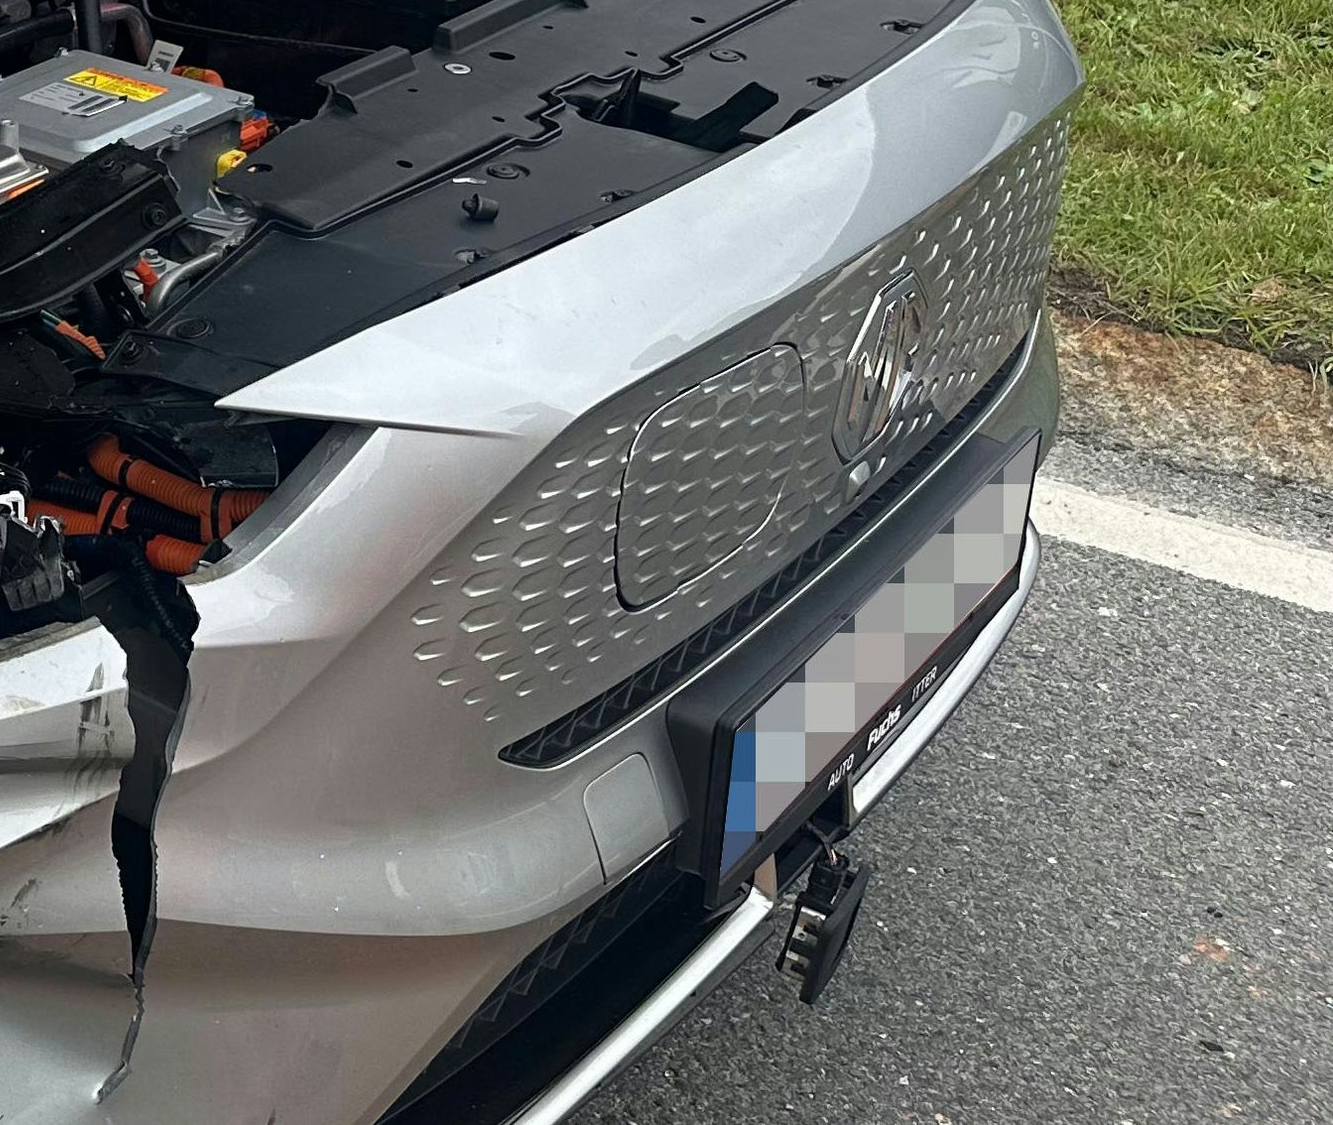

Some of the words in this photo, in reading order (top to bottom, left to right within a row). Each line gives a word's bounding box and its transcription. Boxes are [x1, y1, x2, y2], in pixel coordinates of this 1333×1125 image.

[827, 753, 855, 792] AUTO
[866, 704, 902, 752] Fuchs
[911, 665, 938, 703] ITTER
